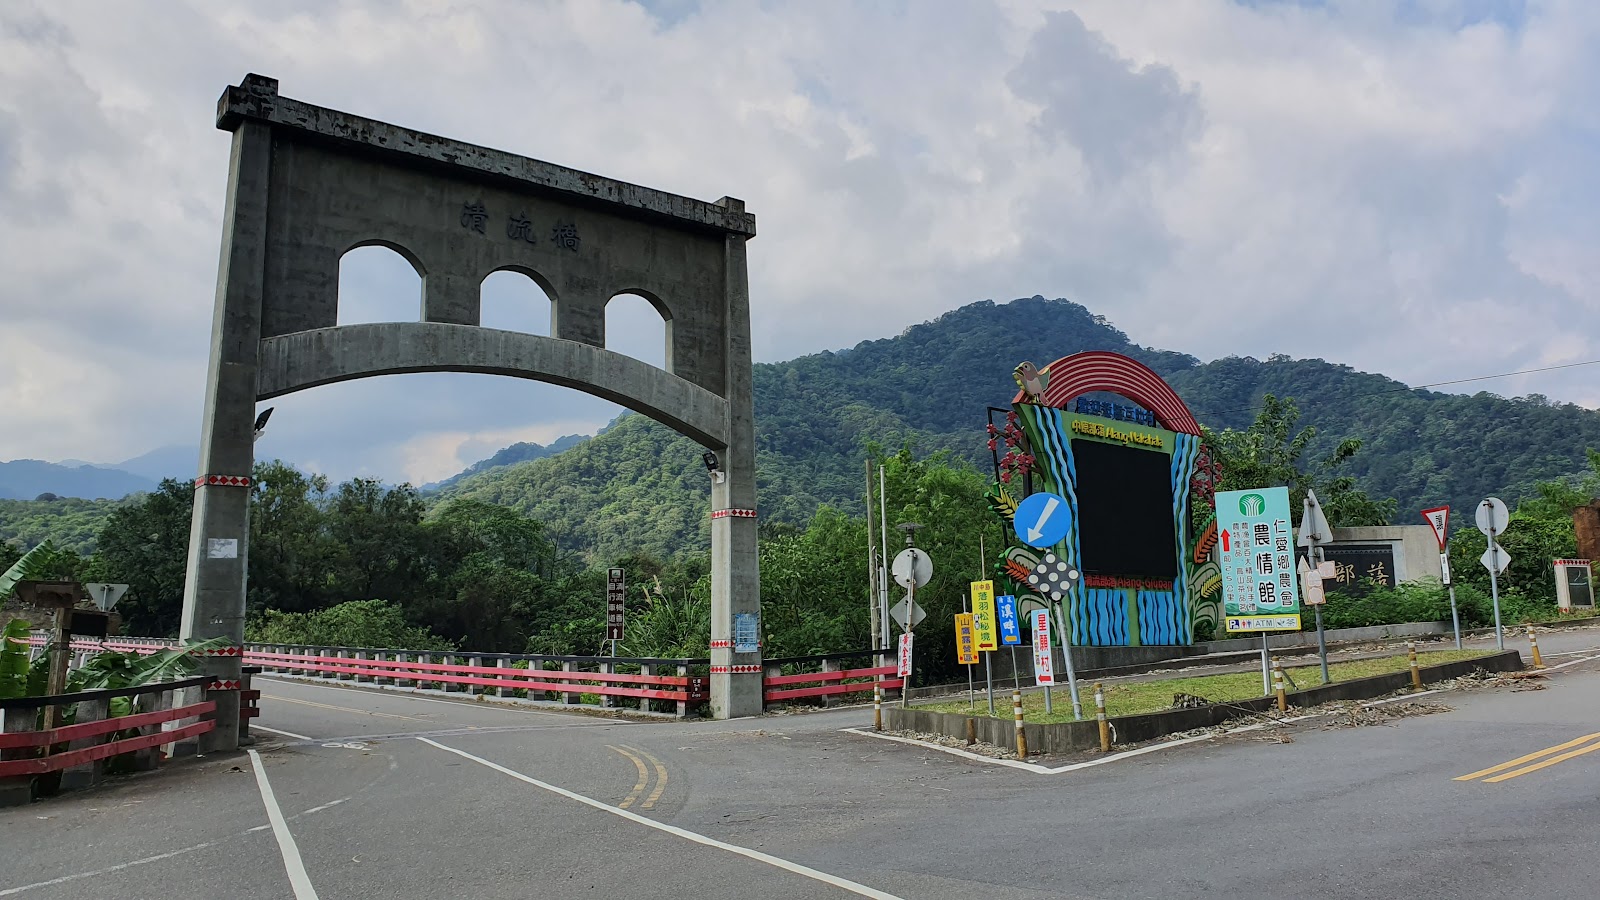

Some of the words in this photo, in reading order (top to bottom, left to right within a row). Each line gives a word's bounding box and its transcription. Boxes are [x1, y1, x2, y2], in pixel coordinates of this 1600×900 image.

[460, 199, 582, 252] 清流橋
[1254, 524, 1276, 603] 農情館
[1273, 519, 1293, 606] 仁愛鄉農會
[1335, 561, 1390, 586] 部落
[978, 592, 991, 641] 落羽松秘境
[1256, 619, 1272, 627] ATM
